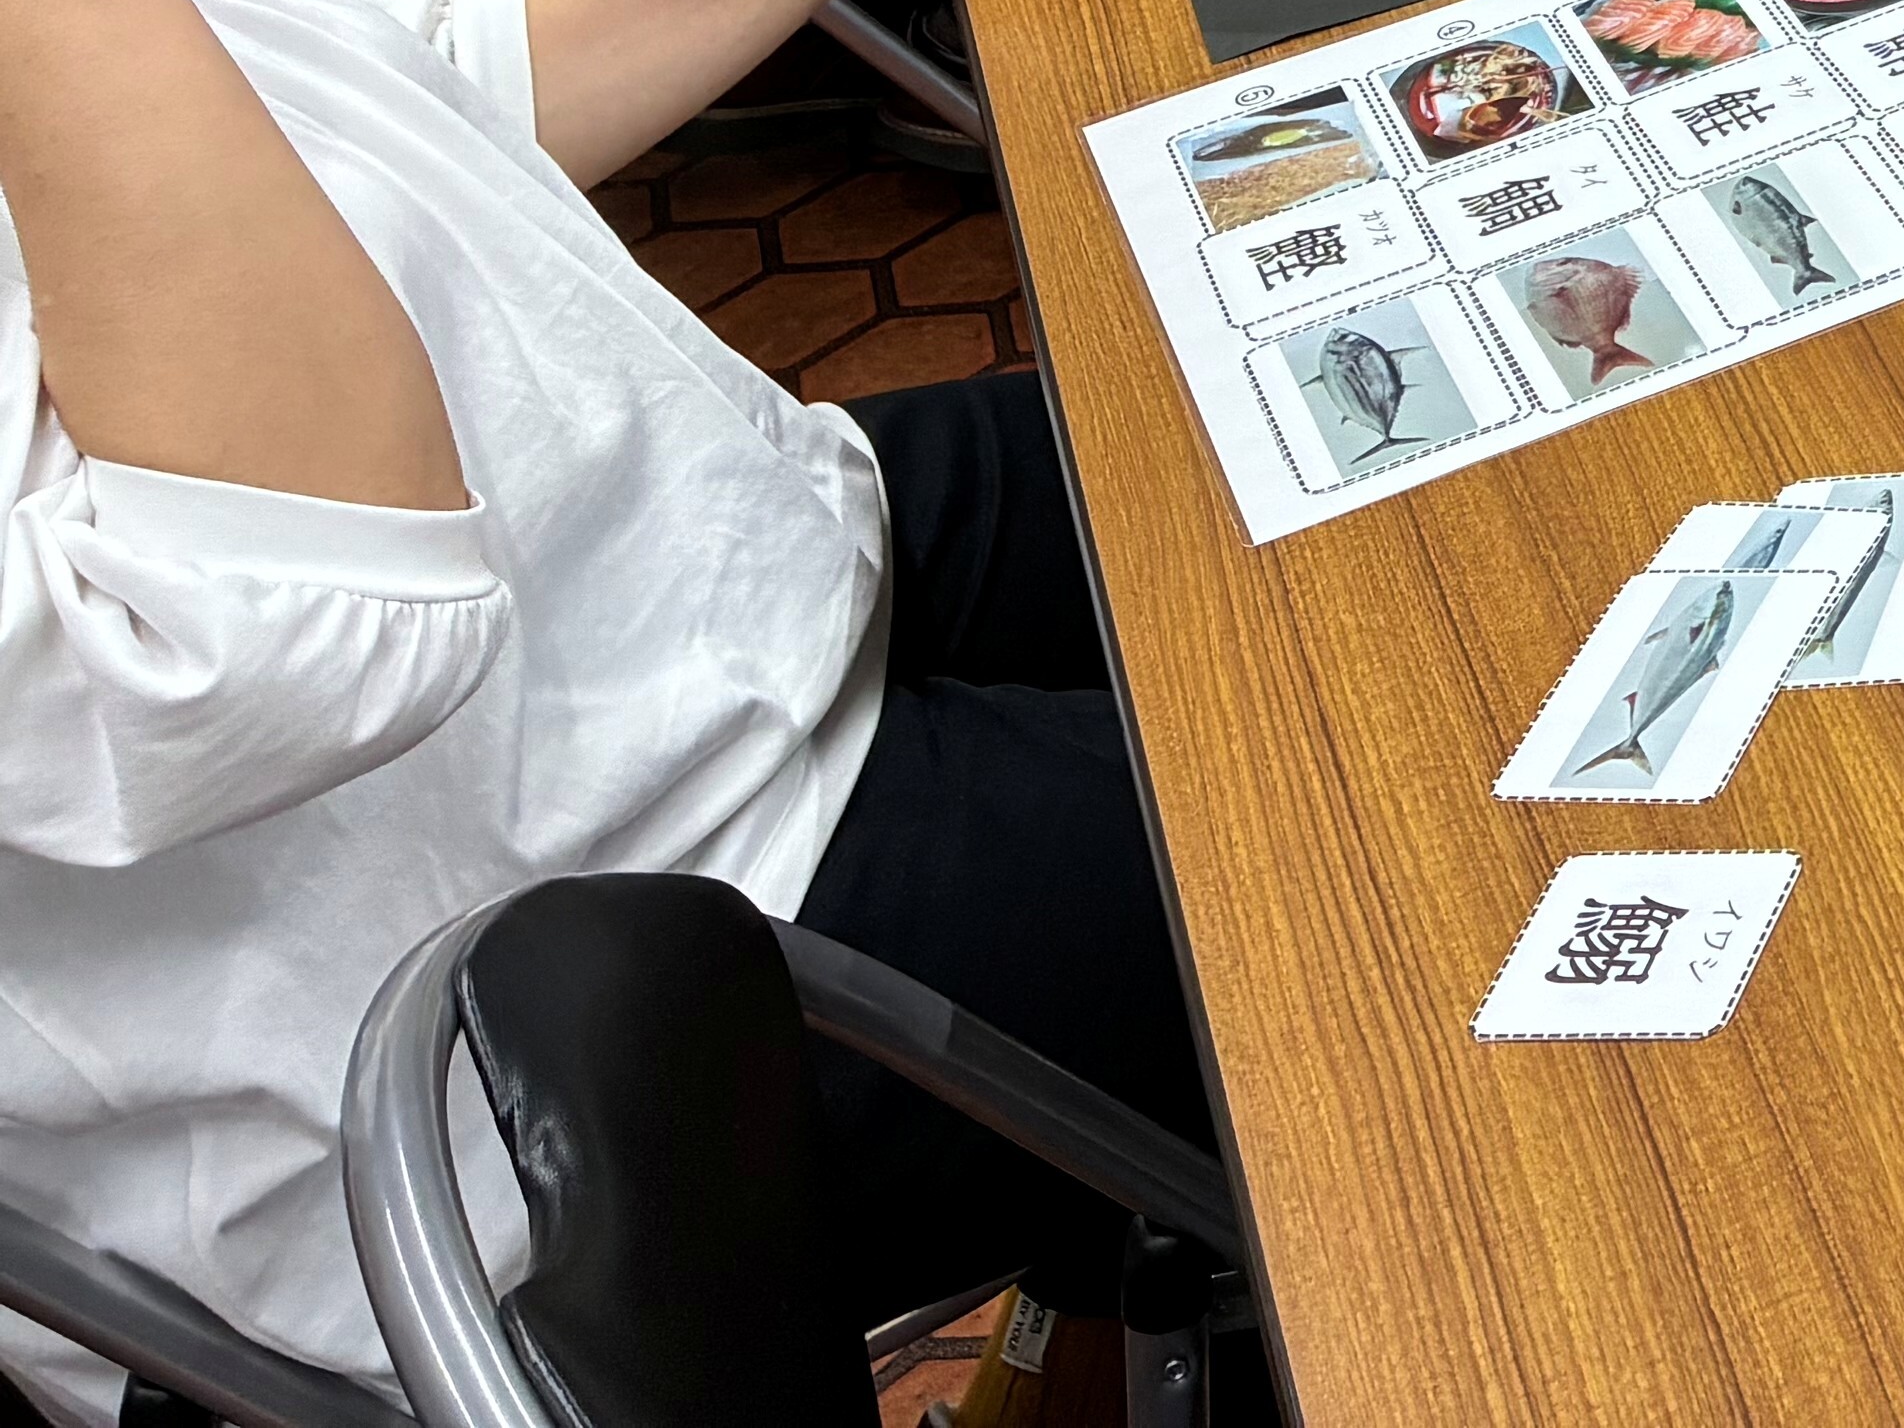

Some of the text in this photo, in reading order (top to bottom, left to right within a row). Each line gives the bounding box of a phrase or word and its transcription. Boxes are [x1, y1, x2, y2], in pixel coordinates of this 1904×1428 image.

[1671, 85, 1778, 147] 鮭
[1779, 73, 1811, 99] サケ
[1457, 175, 1564, 238] 鯛
[1569, 163, 1610, 189] タイ
[1245, 223, 1349, 292] 鰹
[1357, 208, 1399, 248] カツオ
[1544, 894, 1690, 986] 鰯
[1688, 898, 1743, 984] イワシ
